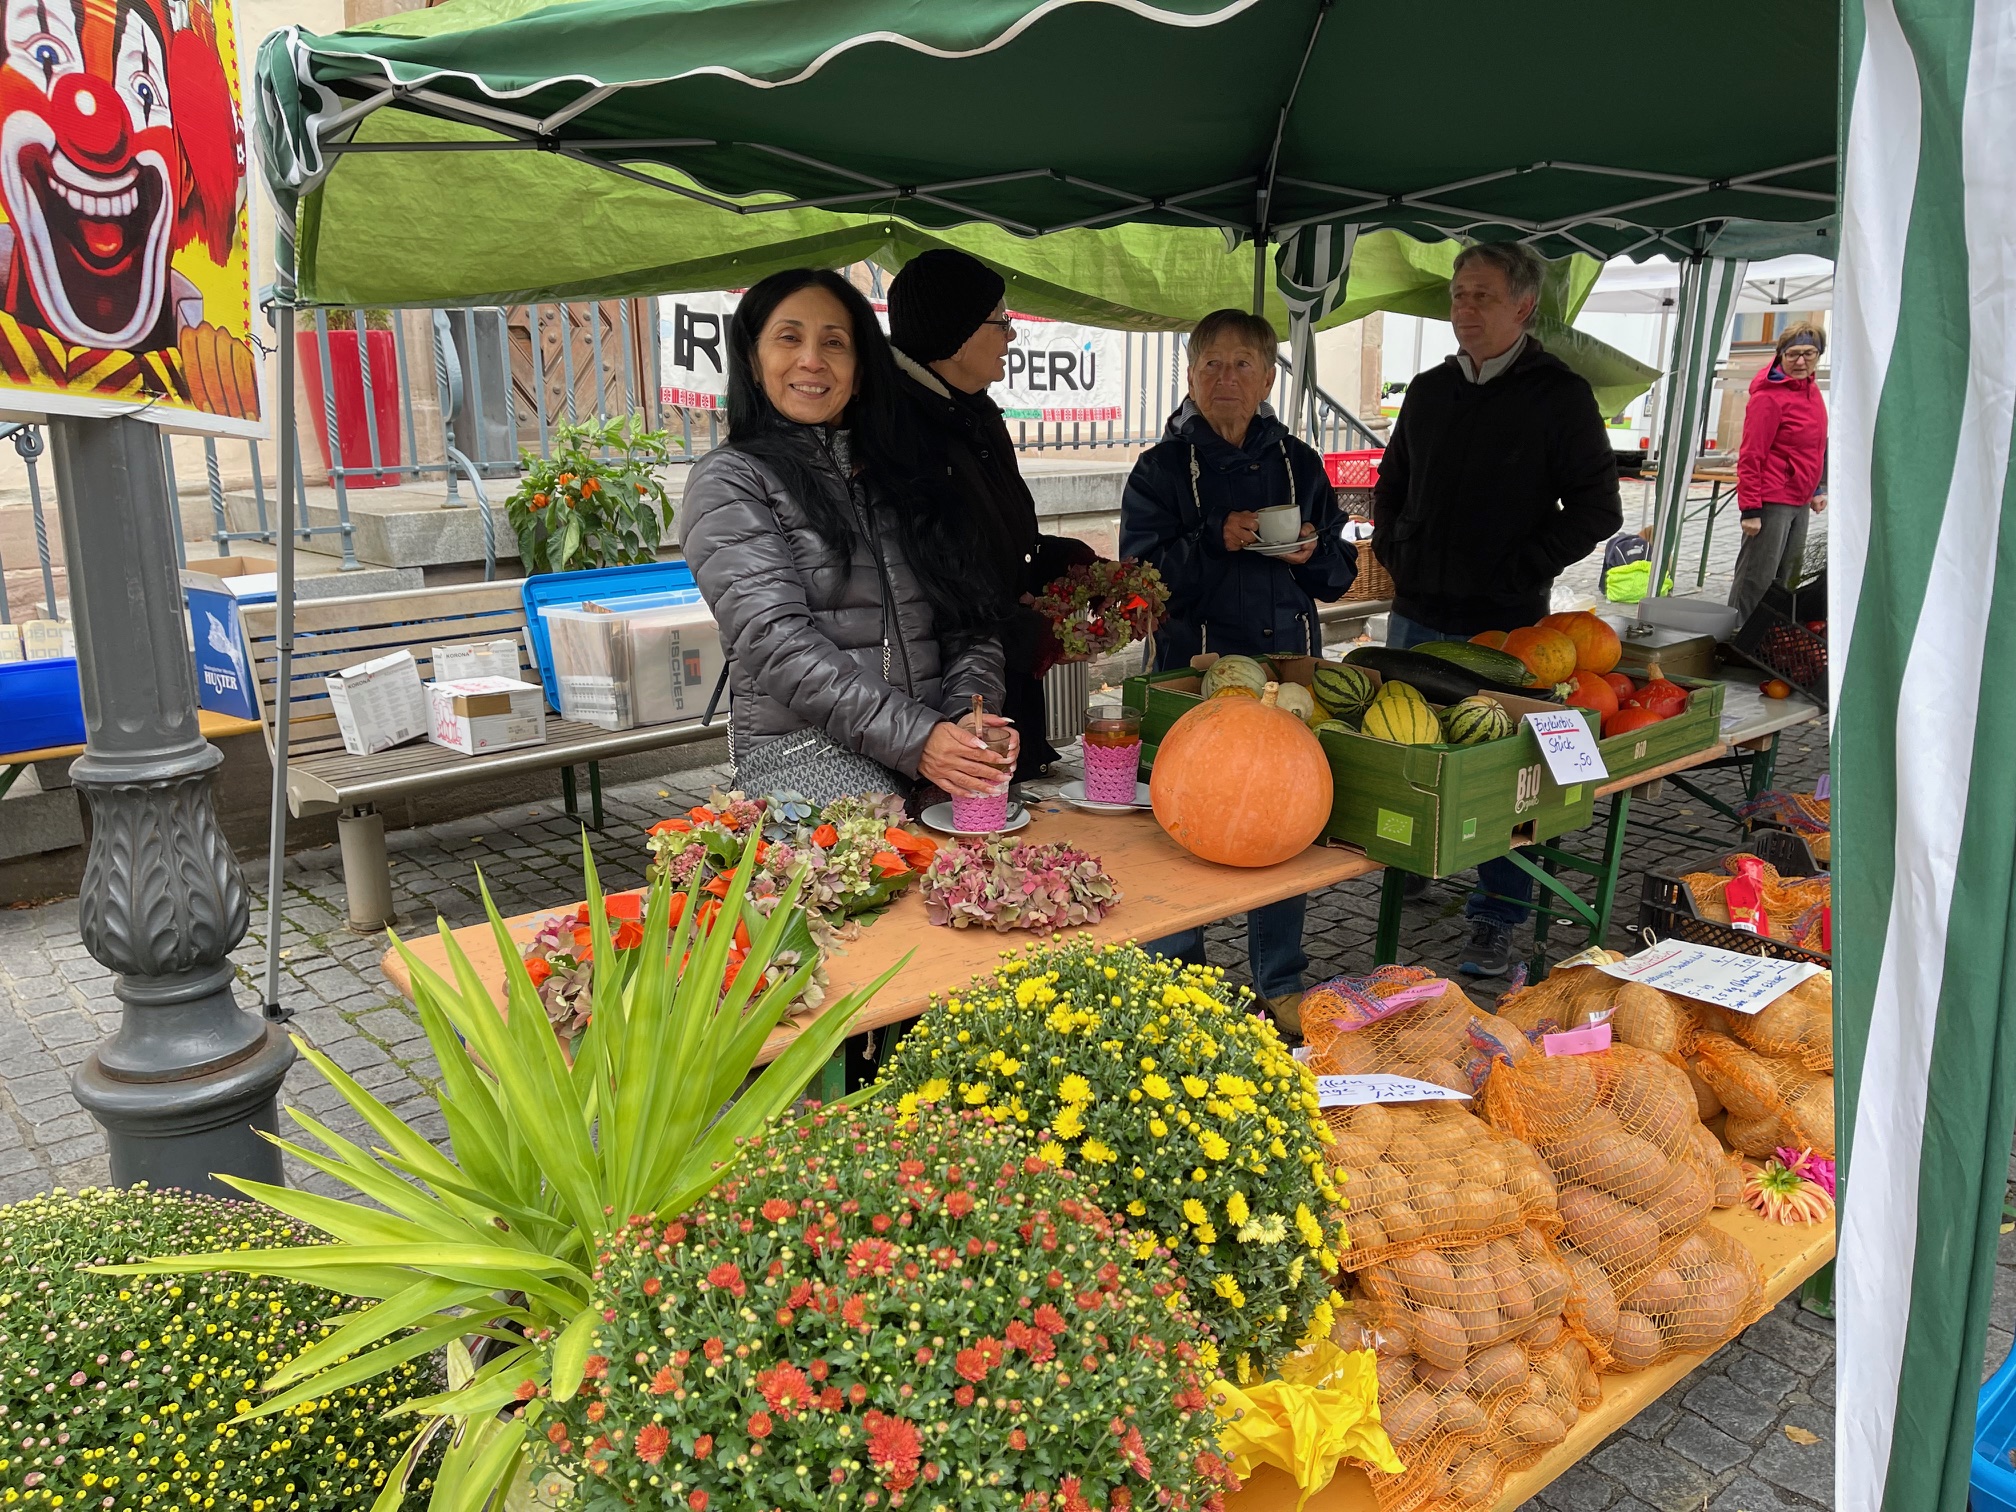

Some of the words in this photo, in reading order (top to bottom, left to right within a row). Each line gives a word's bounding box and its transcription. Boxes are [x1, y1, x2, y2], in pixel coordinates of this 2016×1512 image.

[1016, 326, 1031, 346] ÜR
[1008, 340, 1096, 391] PERÚ
[671, 629, 684, 710] FISCHER
[204, 671, 238, 694] HUSTER
[347, 678, 371, 689] KORONA
[1549, 736, 1575, 753] Stück
